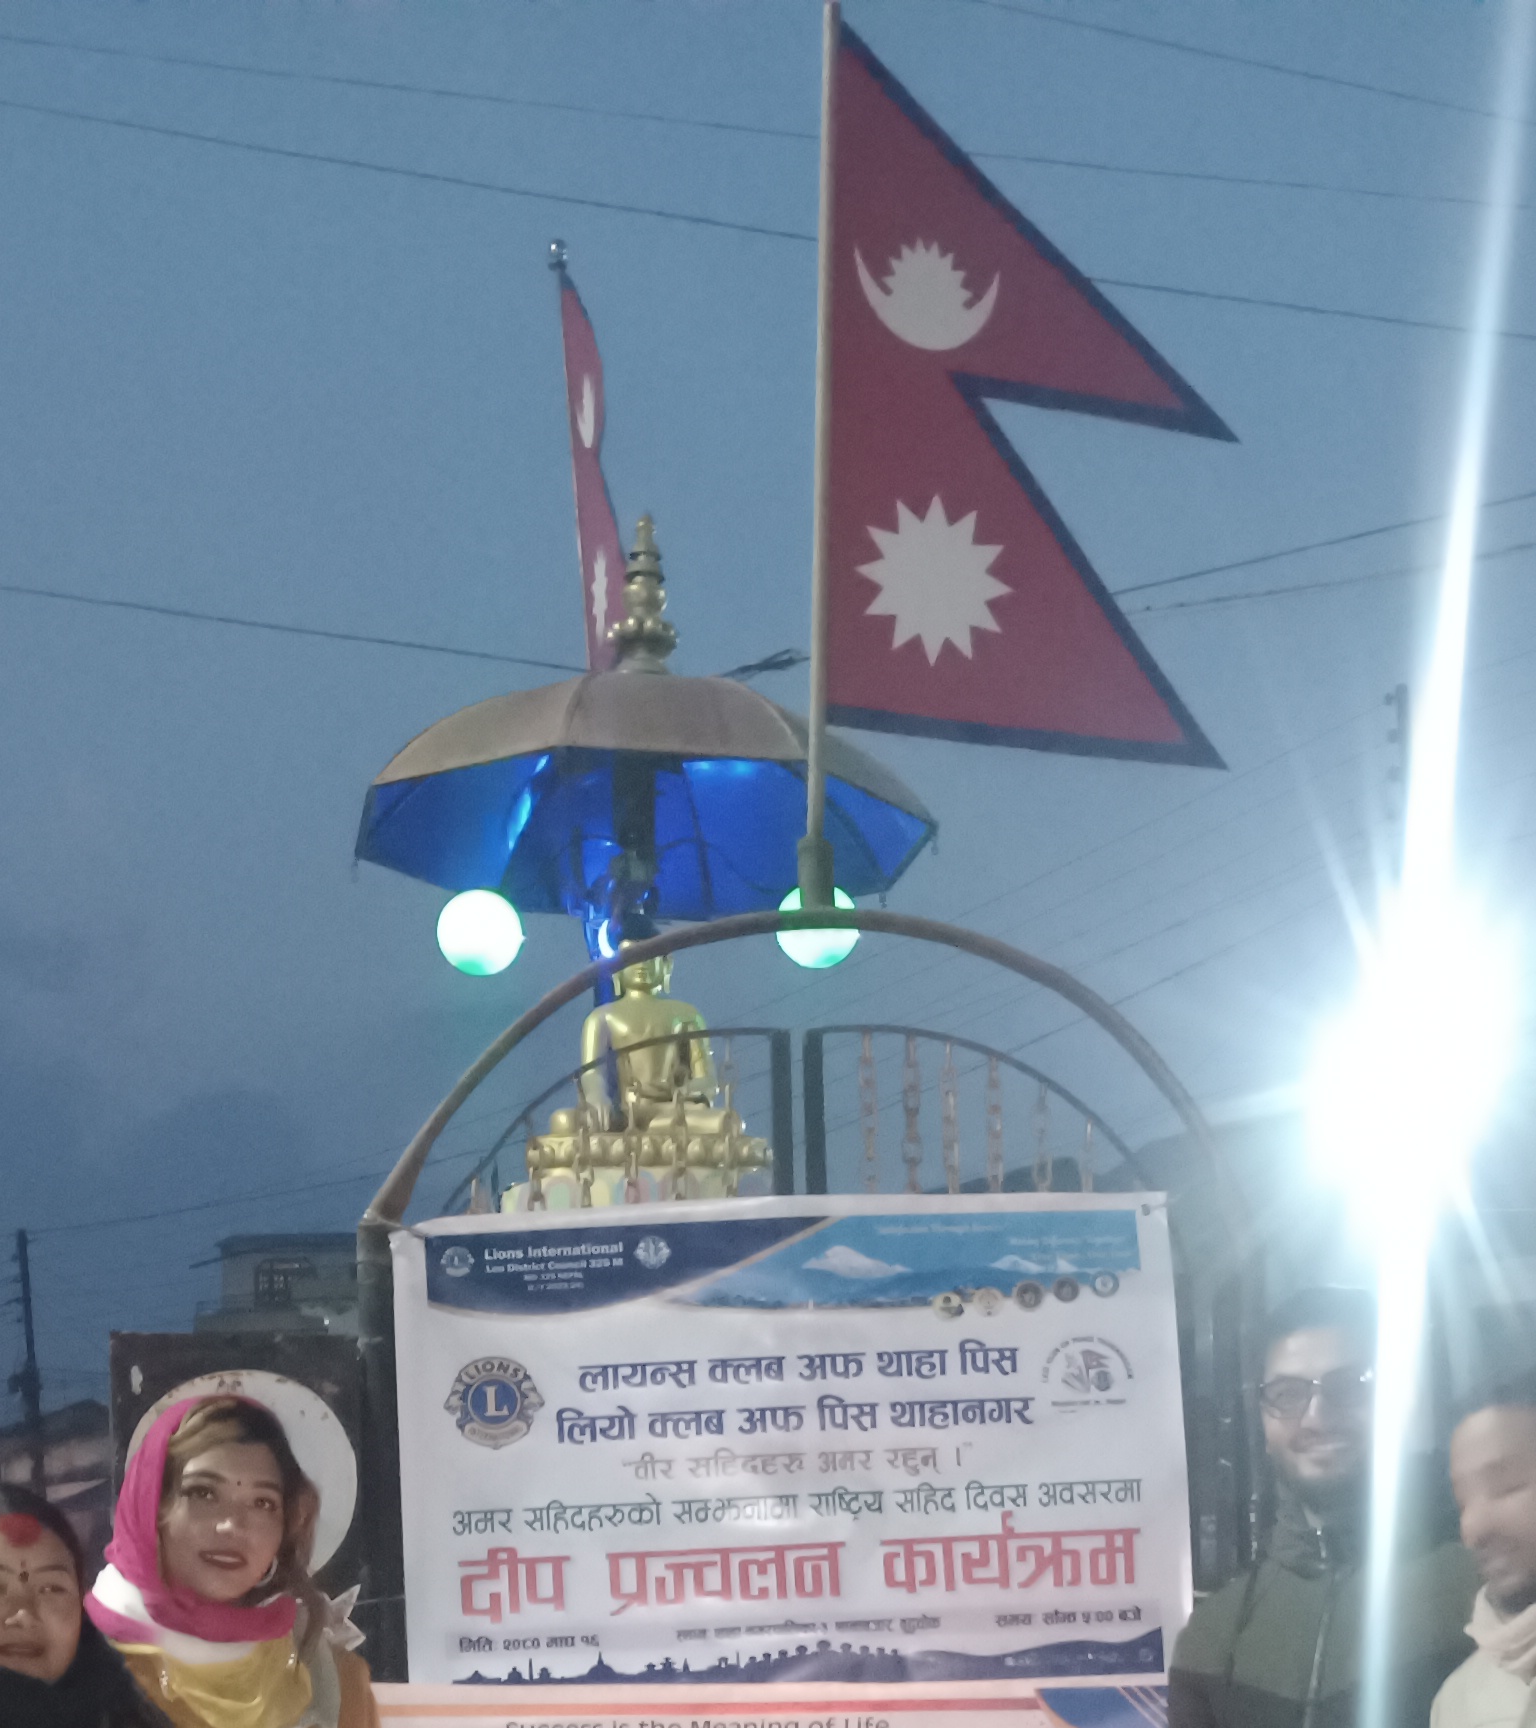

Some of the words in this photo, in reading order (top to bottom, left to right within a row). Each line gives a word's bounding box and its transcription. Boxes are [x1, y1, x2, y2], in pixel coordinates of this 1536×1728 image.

[485, 1248, 524, 1261] Lions
[527, 1241, 624, 1258] International
[465, 1360, 522, 1380] LIONS
[578, 1359, 698, 1393] लायन्स
[708, 1355, 786, 1385] क्लब
[797, 1351, 866, 1381] अफ
[877, 1348, 949, 1380] थाहा
[958, 1338, 1020, 1376] पिस
[483, 1385, 511, 1417] L
[556, 1405, 638, 1445] लियो
[648, 1408, 727, 1440] क्लब
[735, 1405, 807, 1435] अफ
[817, 1394, 879, 1432] पिस
[889, 1396, 1036, 1430] थाहानगर
[818, 1449, 875, 1475] अमर
[452, 1508, 514, 1537] अमर
[893, 1482, 957, 1516] सहिद
[965, 1480, 1029, 1512] दिवस
[1037, 1478, 1143, 1508] अवसरमा
[458, 1546, 572, 1624] दीप
[606, 1541, 847, 1617] प्रज्वलन
[880, 1510, 1142, 1595] कार्यक्रम
